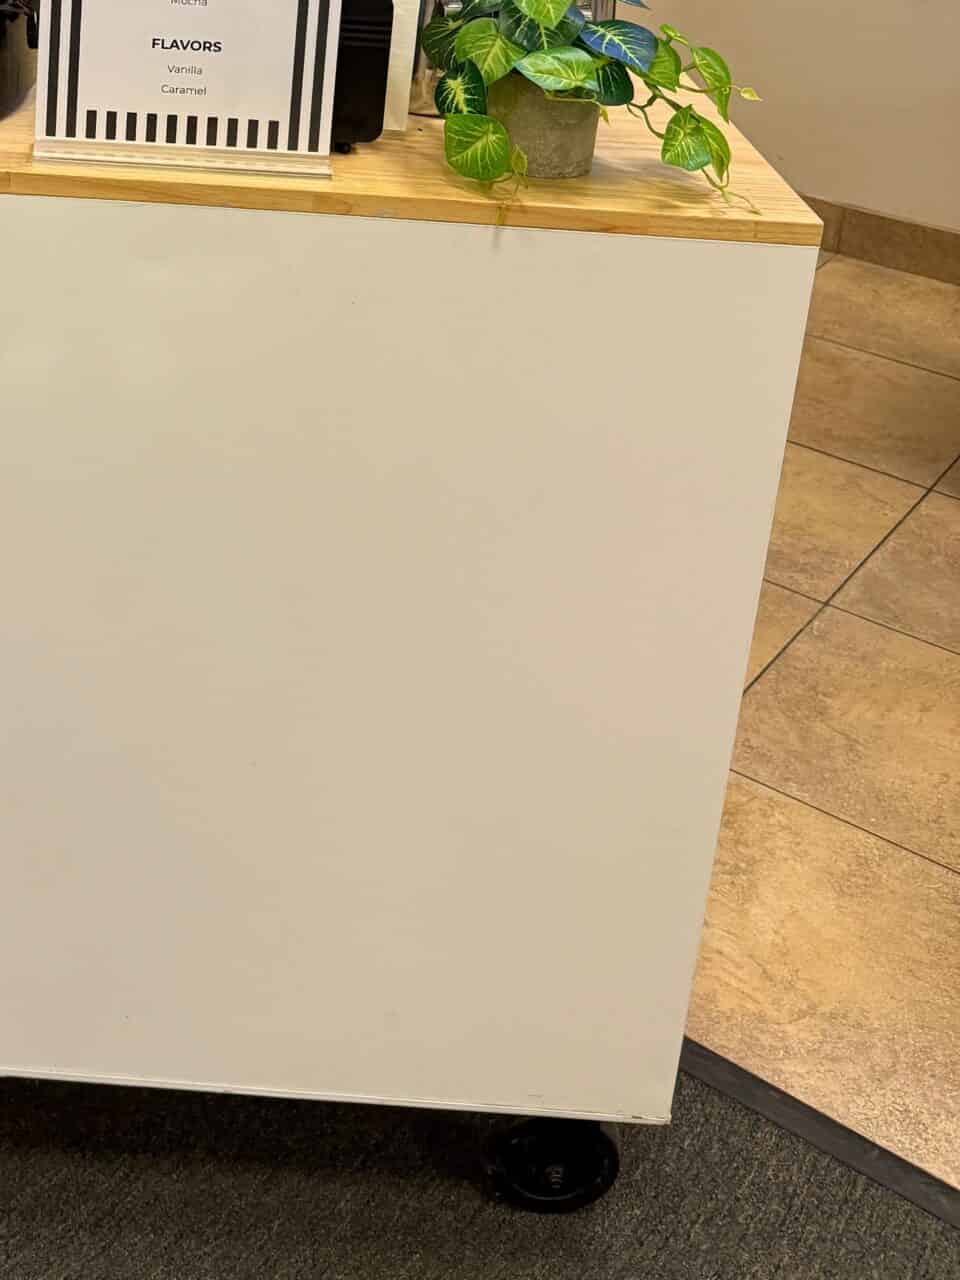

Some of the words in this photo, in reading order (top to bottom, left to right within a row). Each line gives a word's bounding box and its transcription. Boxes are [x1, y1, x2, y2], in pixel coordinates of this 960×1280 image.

[152, 38, 223, 53] FLAVORS
[167, 64, 203, 76] Vanilla
[161, 84, 207, 96] Caramel
